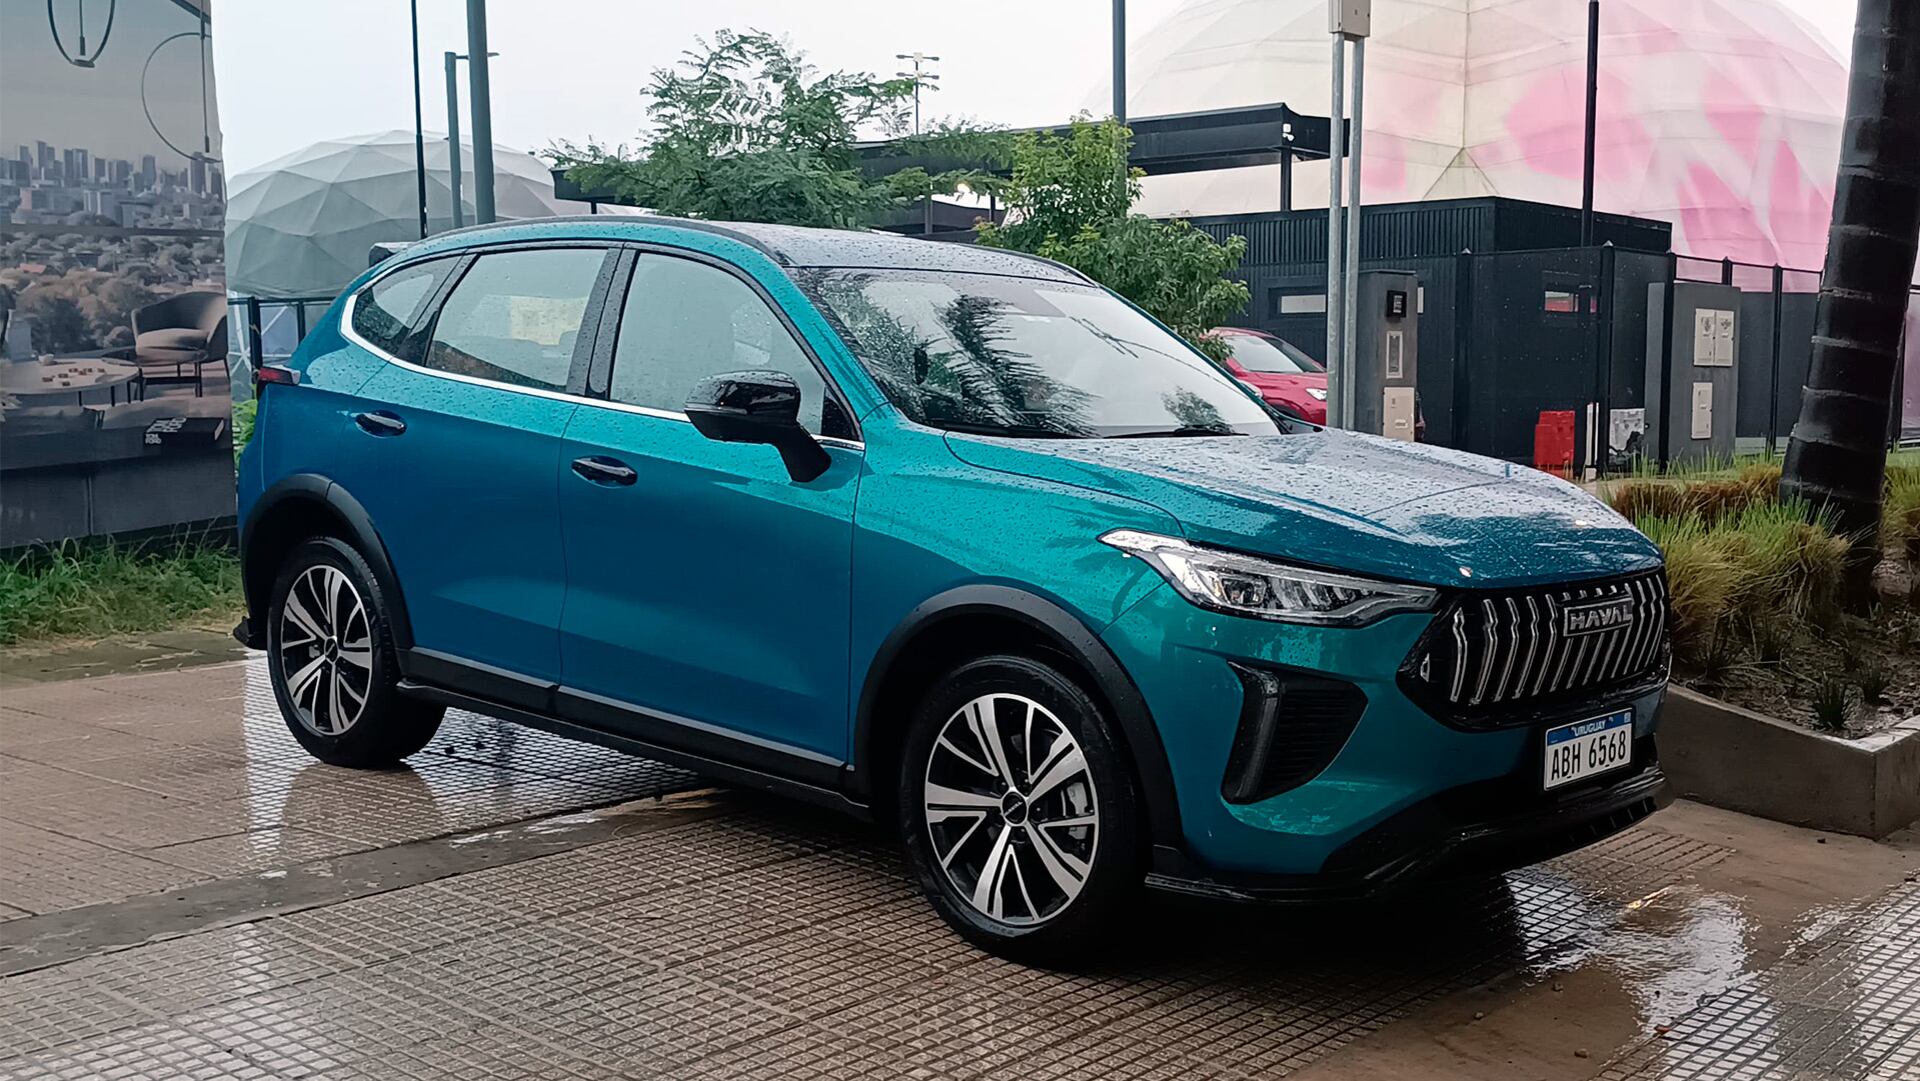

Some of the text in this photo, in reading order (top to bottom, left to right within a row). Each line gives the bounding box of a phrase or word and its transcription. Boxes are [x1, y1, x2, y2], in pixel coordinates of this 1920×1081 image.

[1570, 605, 1633, 630] HAVAL
[1574, 720, 1606, 736] URUGUAY
[1551, 730, 1626, 780] ABH 6568
